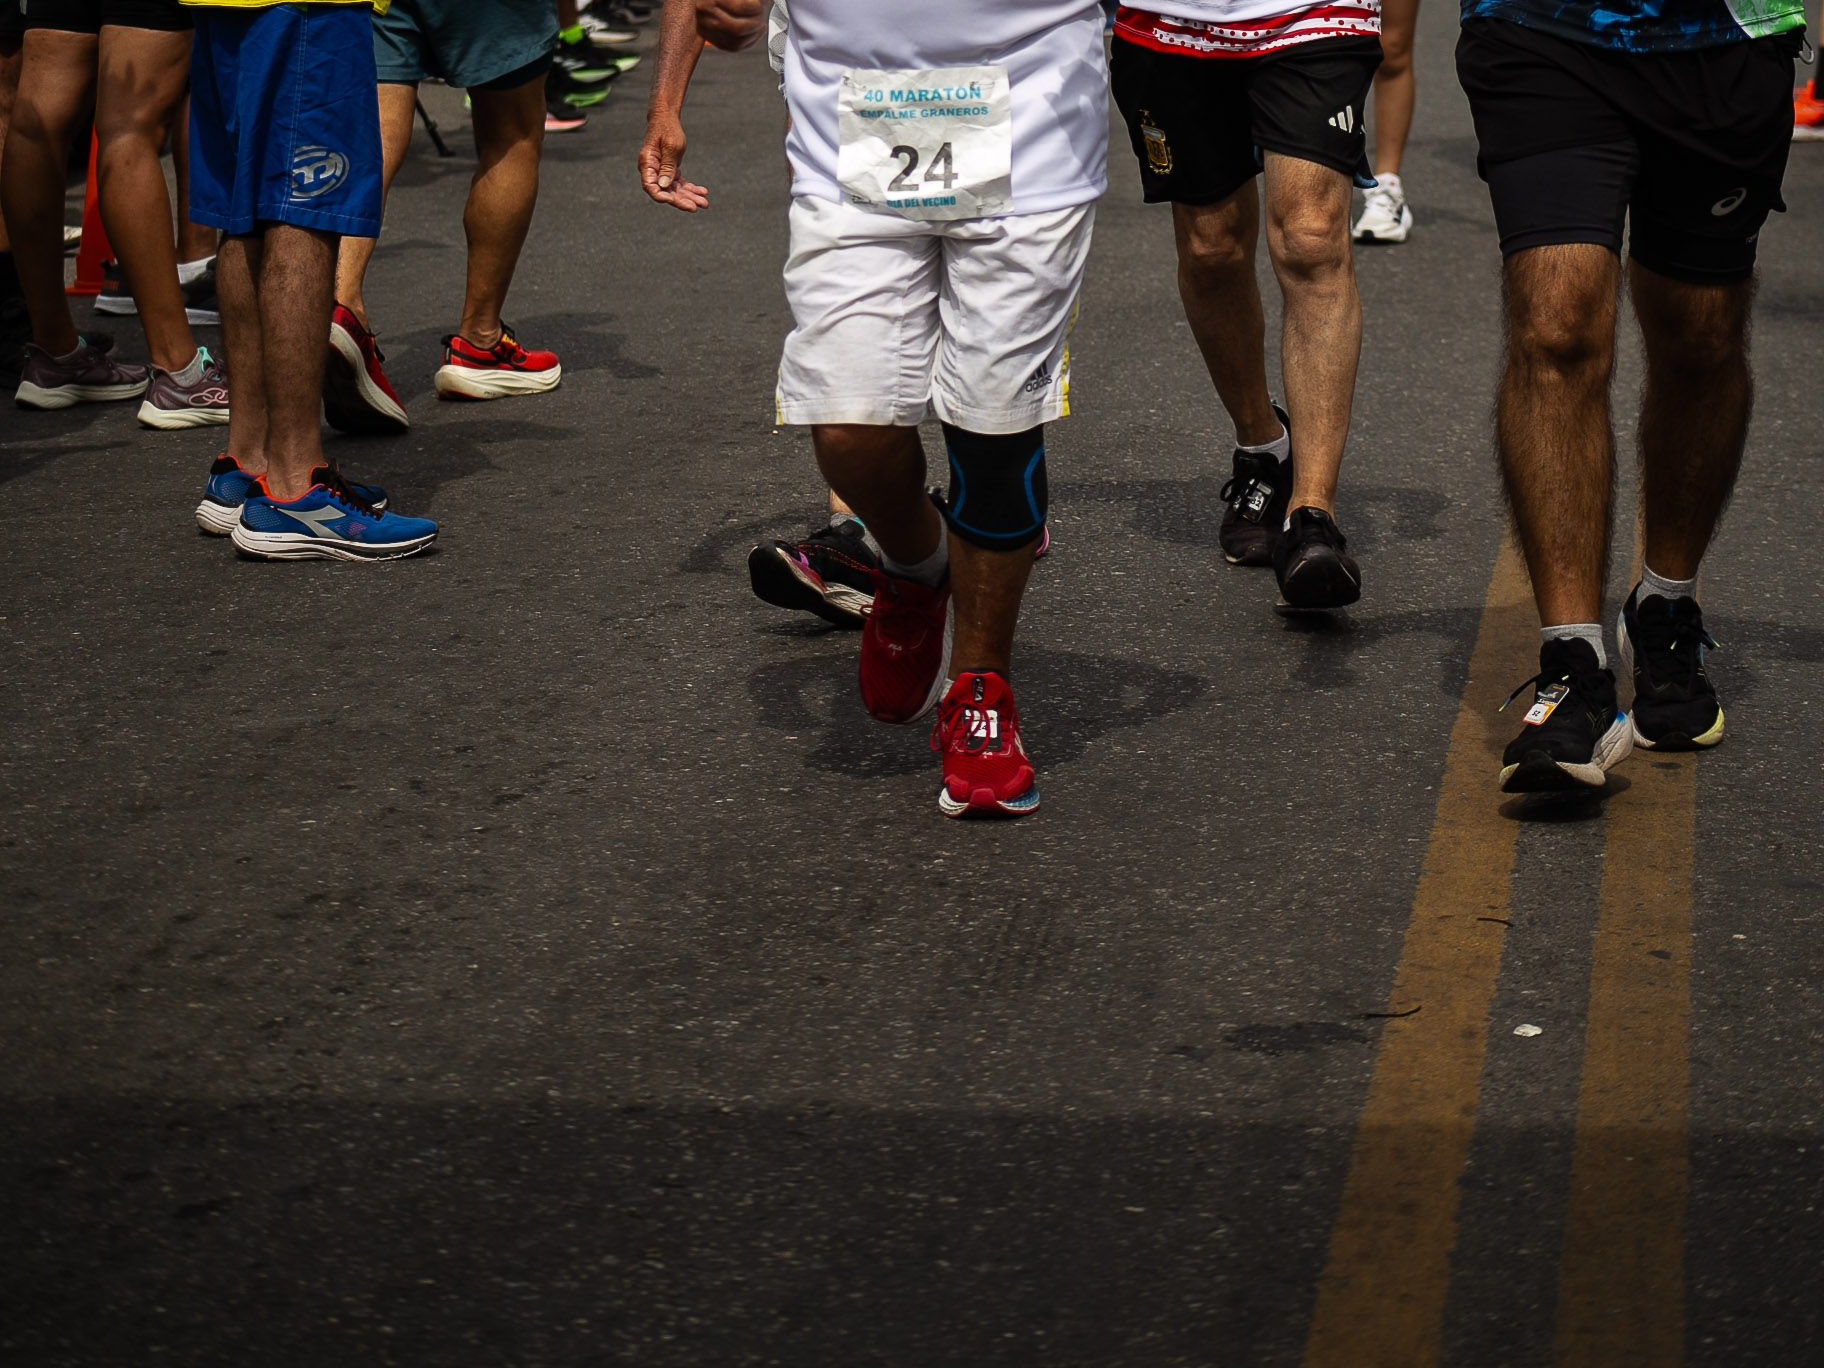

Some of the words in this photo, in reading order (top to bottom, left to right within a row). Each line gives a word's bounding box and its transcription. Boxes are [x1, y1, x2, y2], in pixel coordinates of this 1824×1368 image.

[864, 90, 884, 103] 40
[861, 109, 916, 120] EMPALME
[920, 107, 989, 118] GRANEROS
[887, 142, 959, 192] 24
[904, 198, 920, 208] DEL
[922, 196, 956, 207] VECINO
